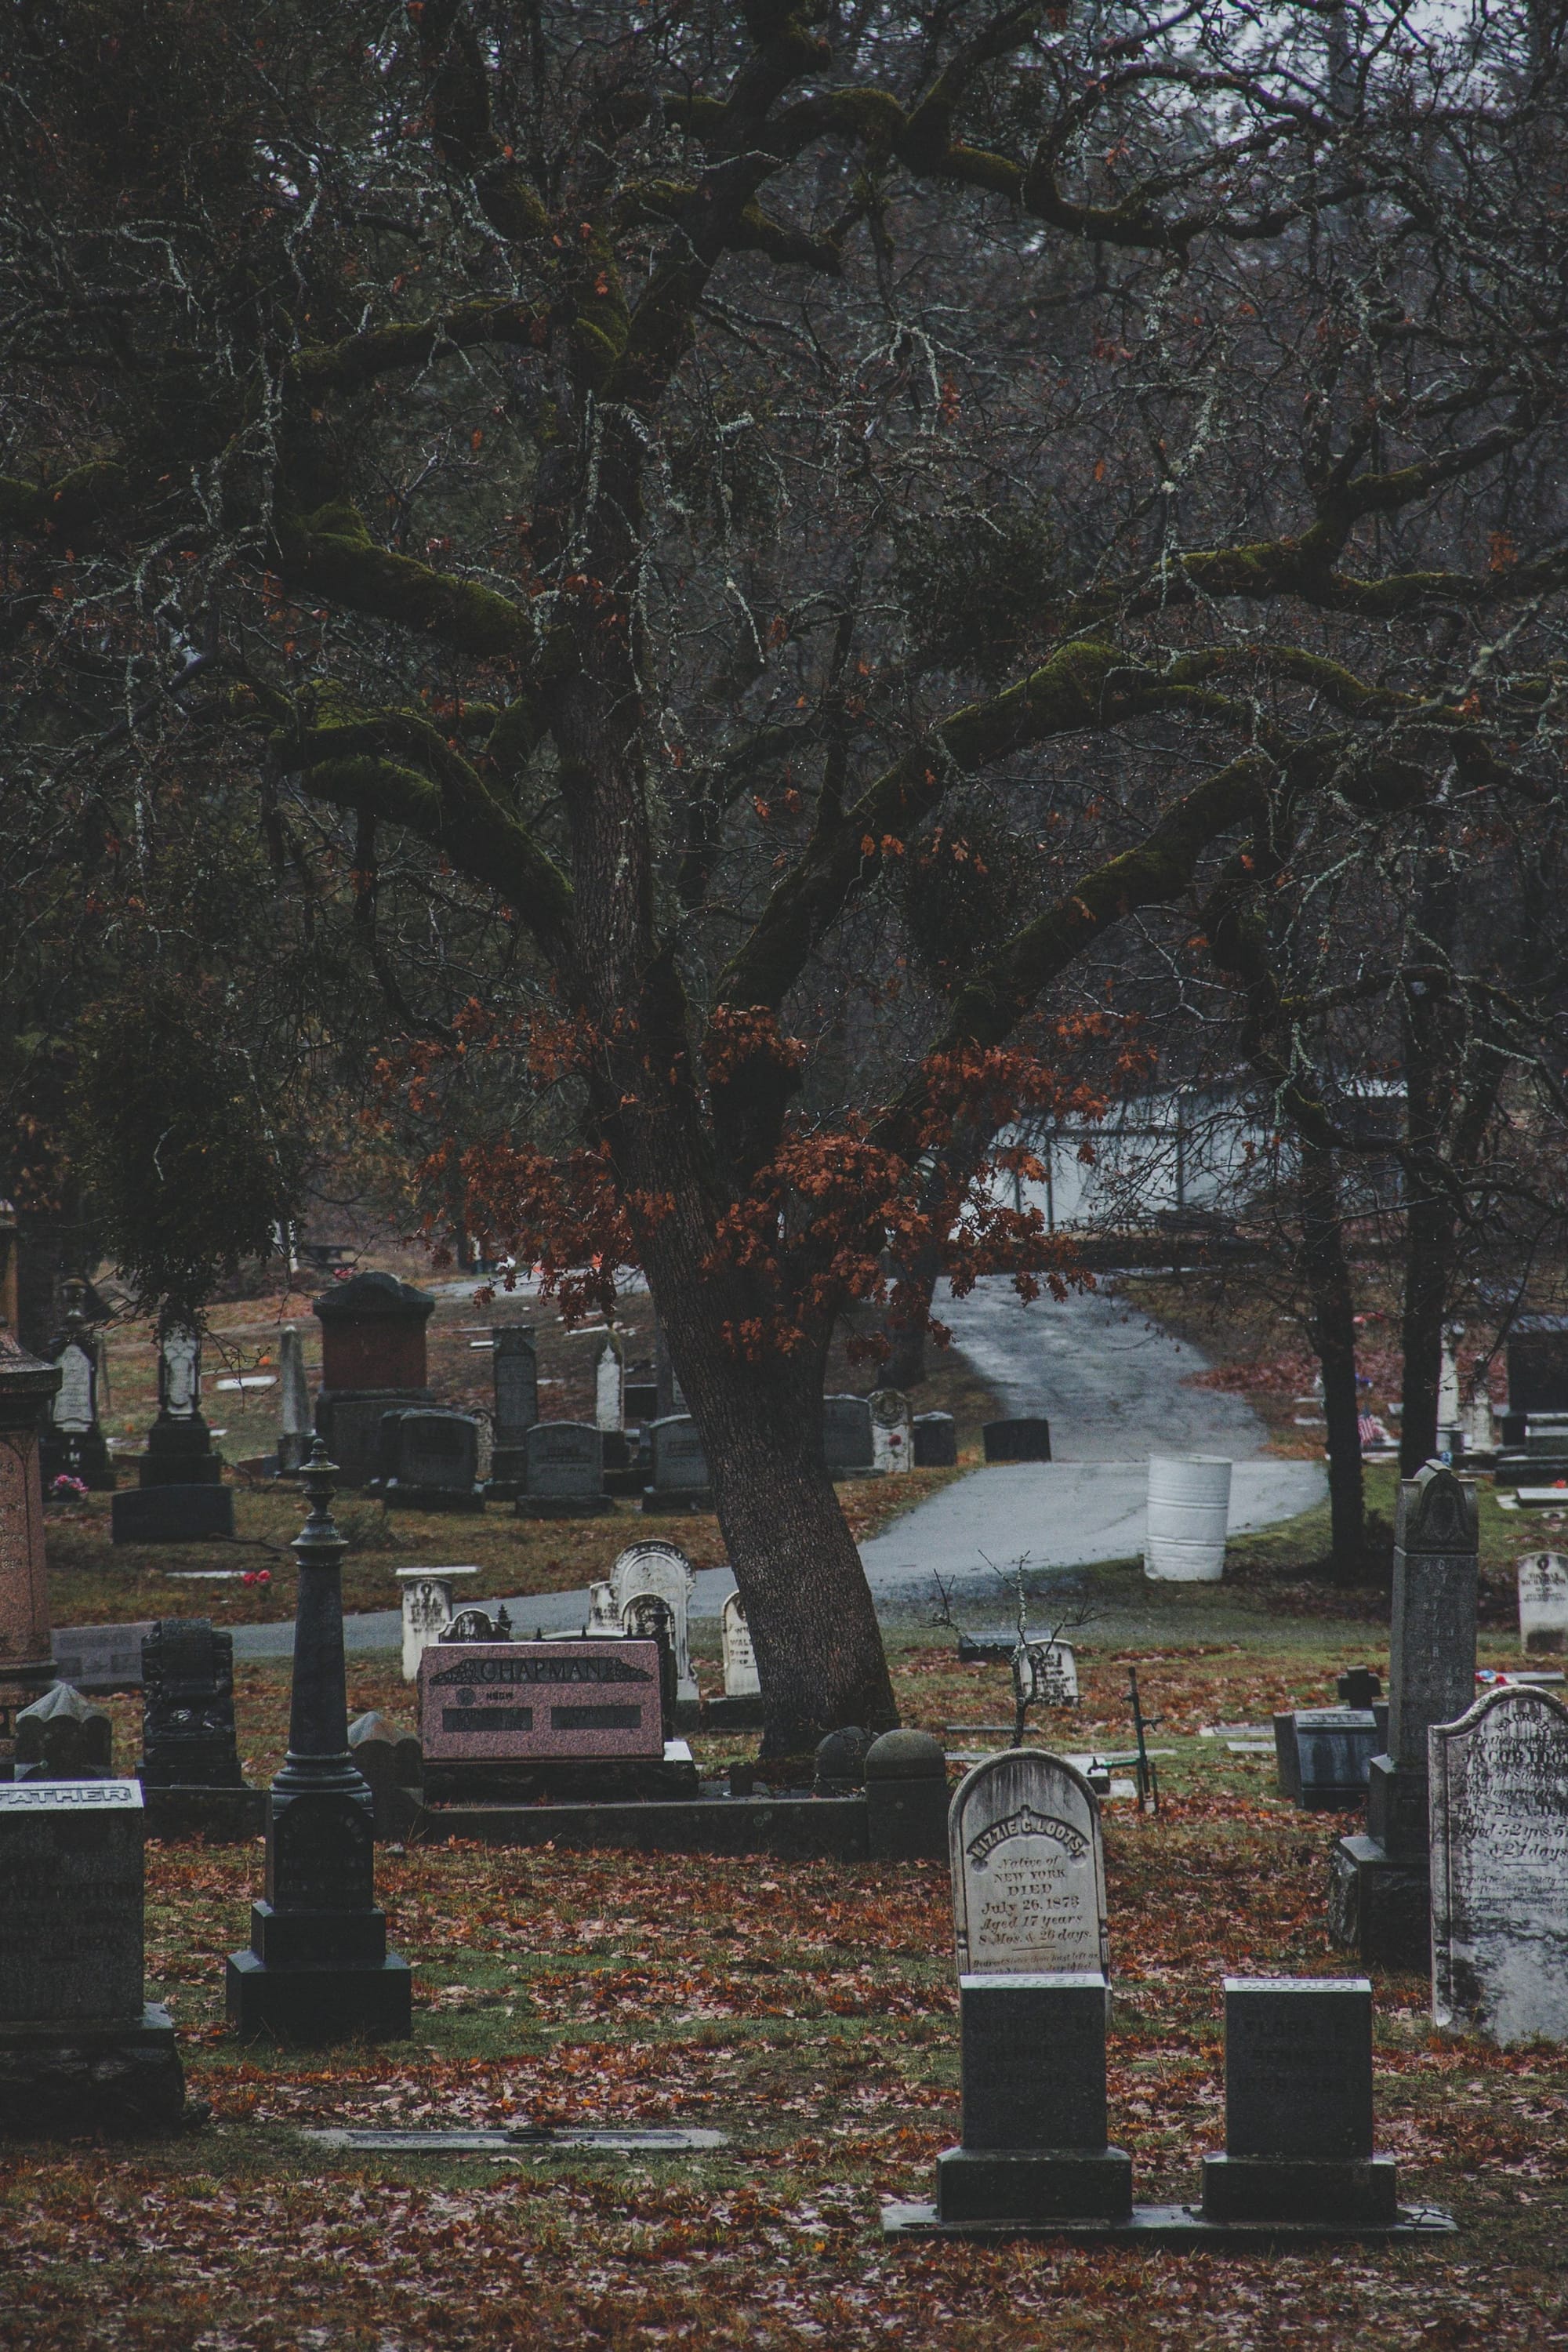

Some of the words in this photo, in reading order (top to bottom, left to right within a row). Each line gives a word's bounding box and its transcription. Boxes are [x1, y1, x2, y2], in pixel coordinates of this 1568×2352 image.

[480, 1659, 603, 1681] CHAPMAN
[1497, 1712, 1550, 1732] SACRED
[1462, 1749, 1523, 1764] JACOB
[971, 1820, 1018, 1859] LIZZIE
[1045, 1855, 1062, 1866] of
[993, 1871, 1025, 1883] NEW
[1030, 1869, 1067, 1881] YORK
[1007, 1883, 1053, 1897] DIED
[981, 1901, 1018, 1918] July
[980, 1916, 1018, 1935] Aged
[1022, 1915, 1039, 1927] 17
[1041, 1914, 1083, 1929] years
[980, 1977, 1087, 1987] FATHER
[1241, 1980, 1355, 1990] MOTHER
